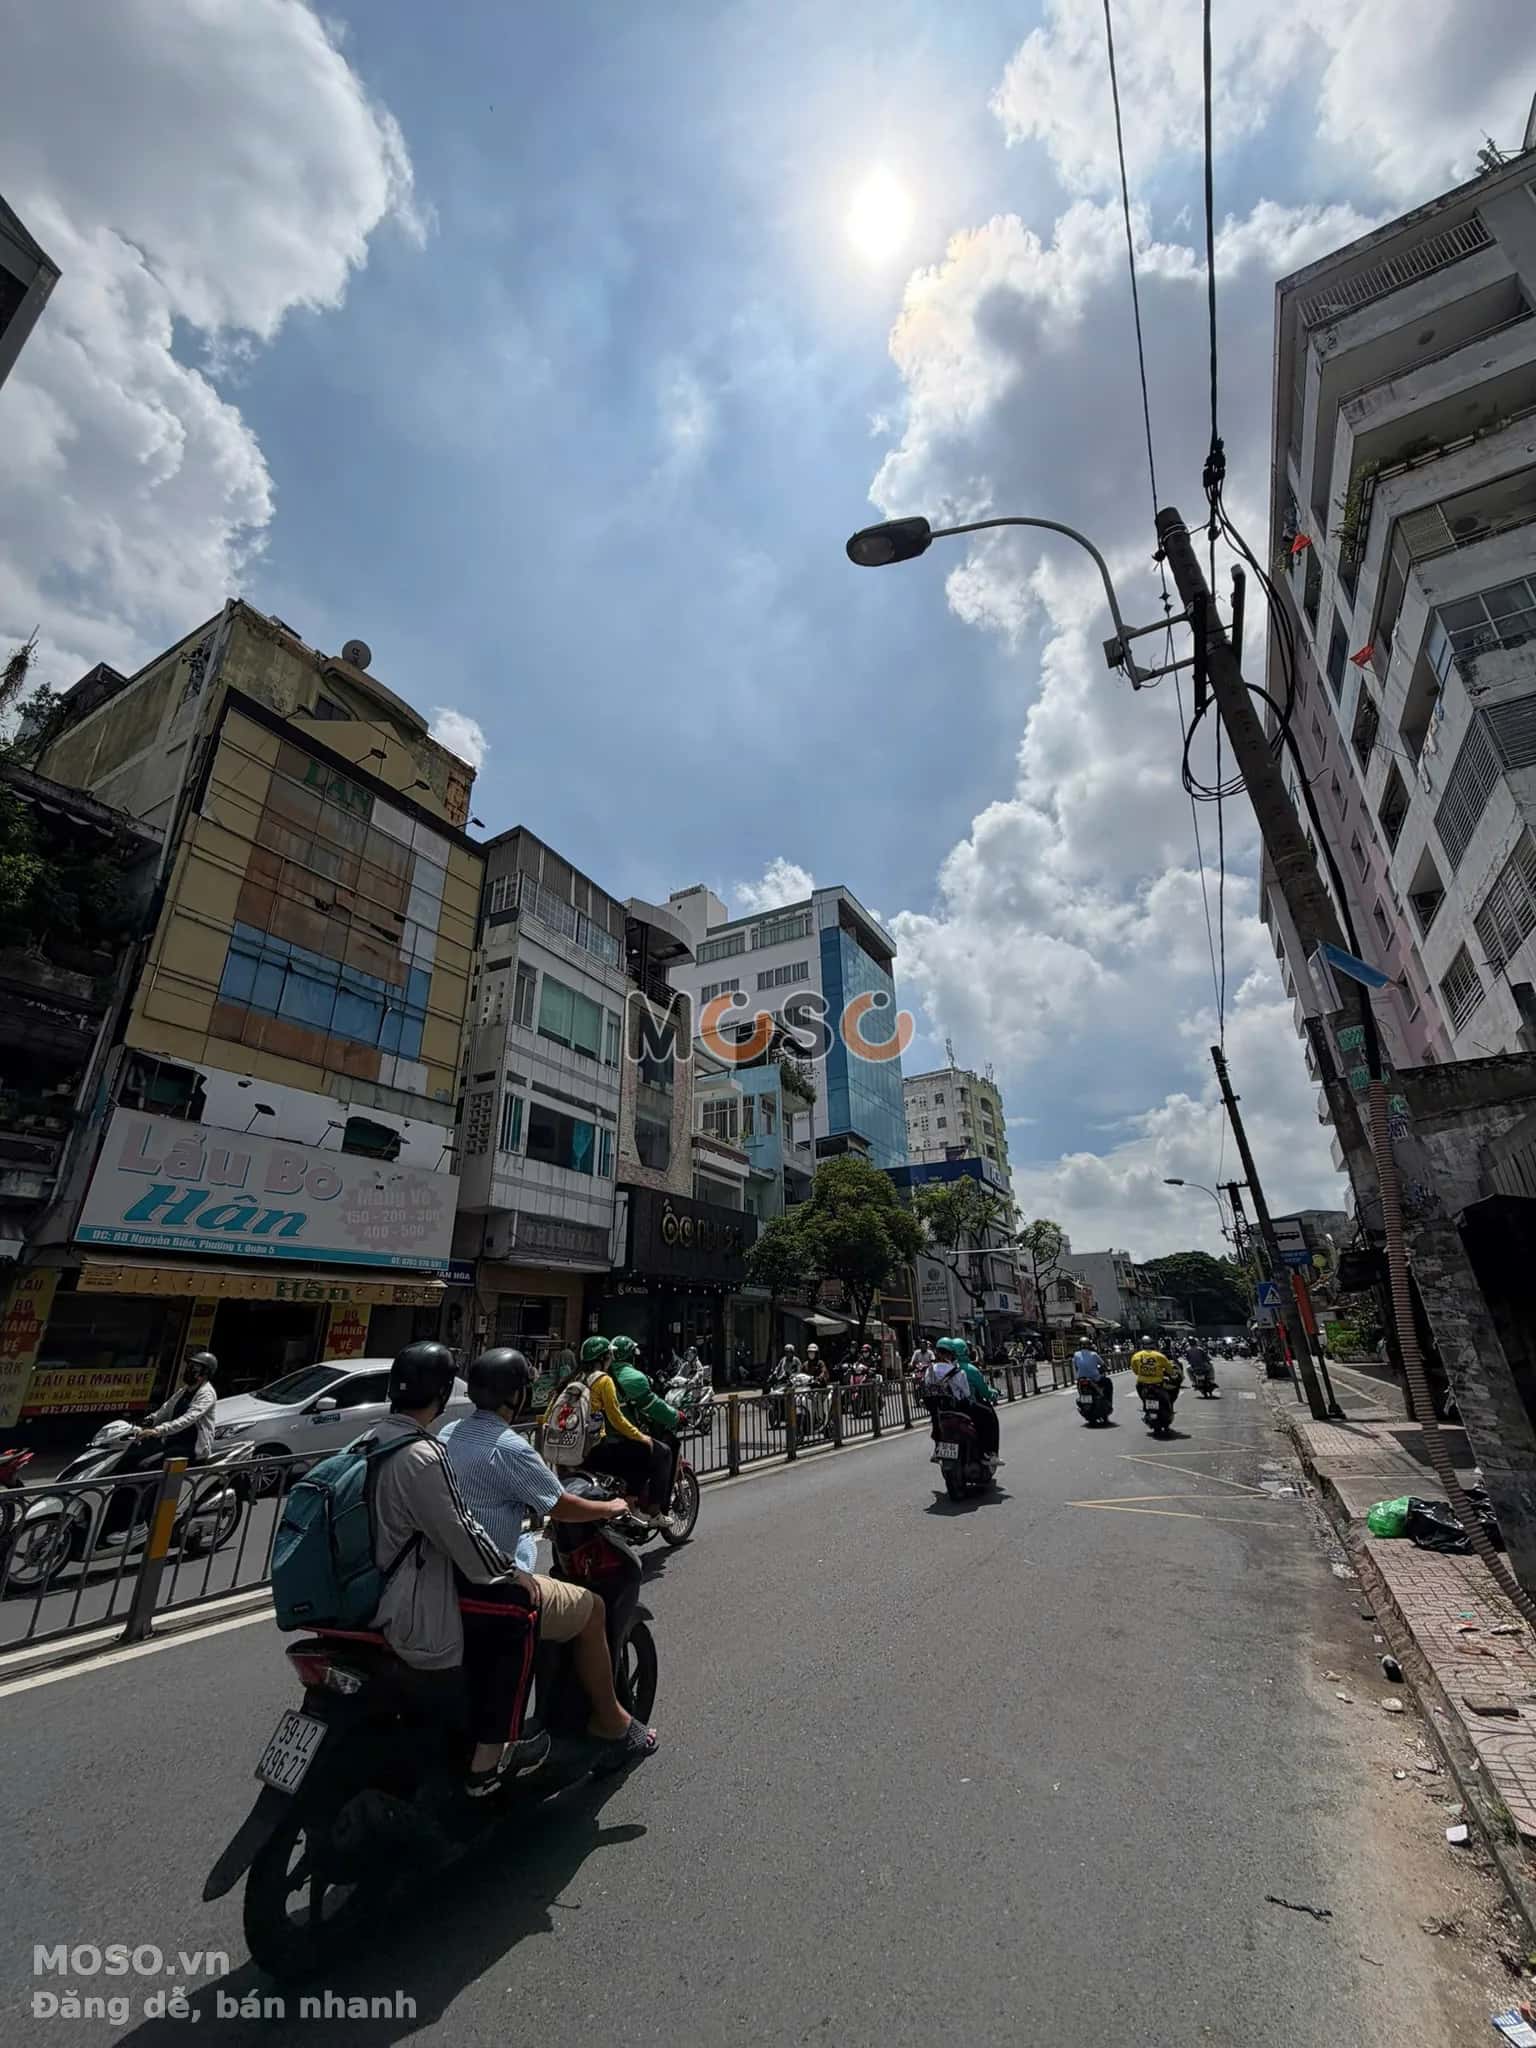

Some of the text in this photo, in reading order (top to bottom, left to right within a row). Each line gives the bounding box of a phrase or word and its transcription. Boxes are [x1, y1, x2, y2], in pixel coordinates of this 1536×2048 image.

[118, 1123, 251, 1187] Lẩu
[123, 1183, 309, 1237] Hân
[383, 1209, 406, 1223] 200
[261, 1746, 307, 1786] 396.27
